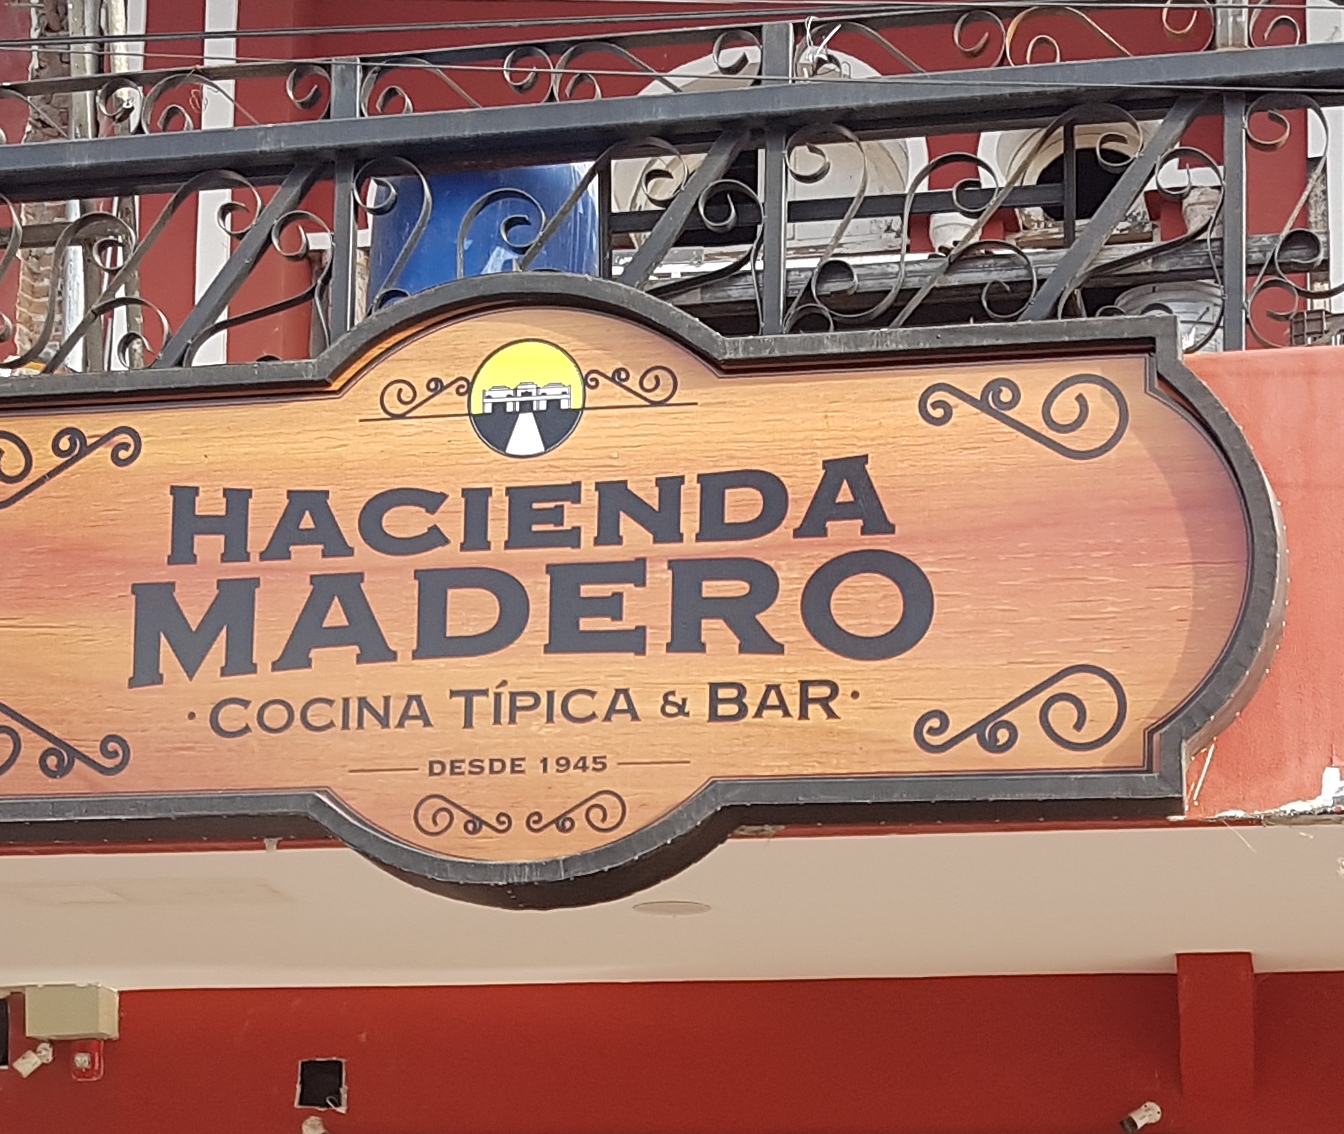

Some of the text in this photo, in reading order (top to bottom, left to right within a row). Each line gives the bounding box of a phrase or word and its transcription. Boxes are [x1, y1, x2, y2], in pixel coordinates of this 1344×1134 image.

[167, 454, 896, 566] HACIENDA
[128, 549, 935, 689] MADERO
[209, 680, 841, 738] COCINA TÍPICA & BAR
[428, 756, 608, 777] DESDE 1945
